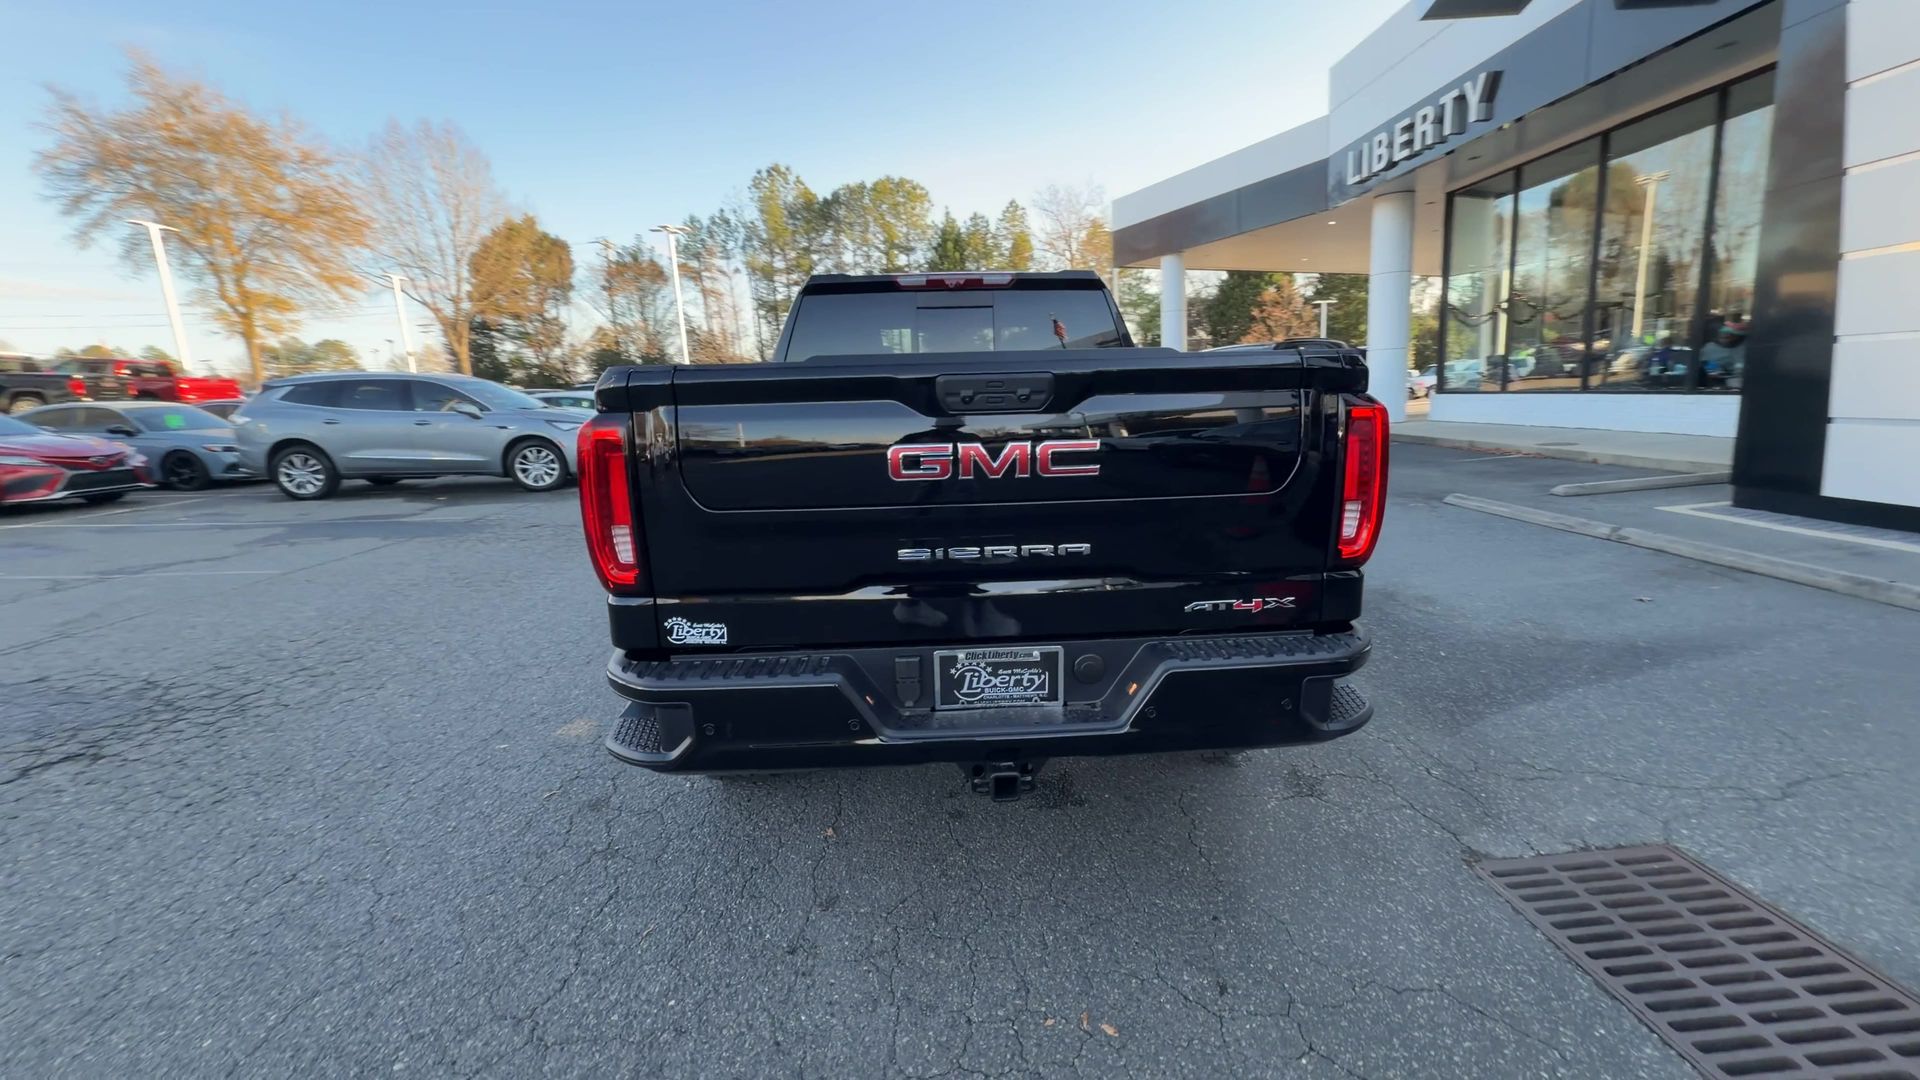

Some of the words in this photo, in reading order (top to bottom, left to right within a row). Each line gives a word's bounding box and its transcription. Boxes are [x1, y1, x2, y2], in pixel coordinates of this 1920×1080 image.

[1347, 71, 1504, 185] LIBERTY
[887, 439, 1100, 481] GMC
[897, 543, 1091, 560] SIERRA
[1184, 597, 1296, 613] AT4X
[671, 624, 725, 640] Liberty
[960, 670, 1046, 693] Liberty
